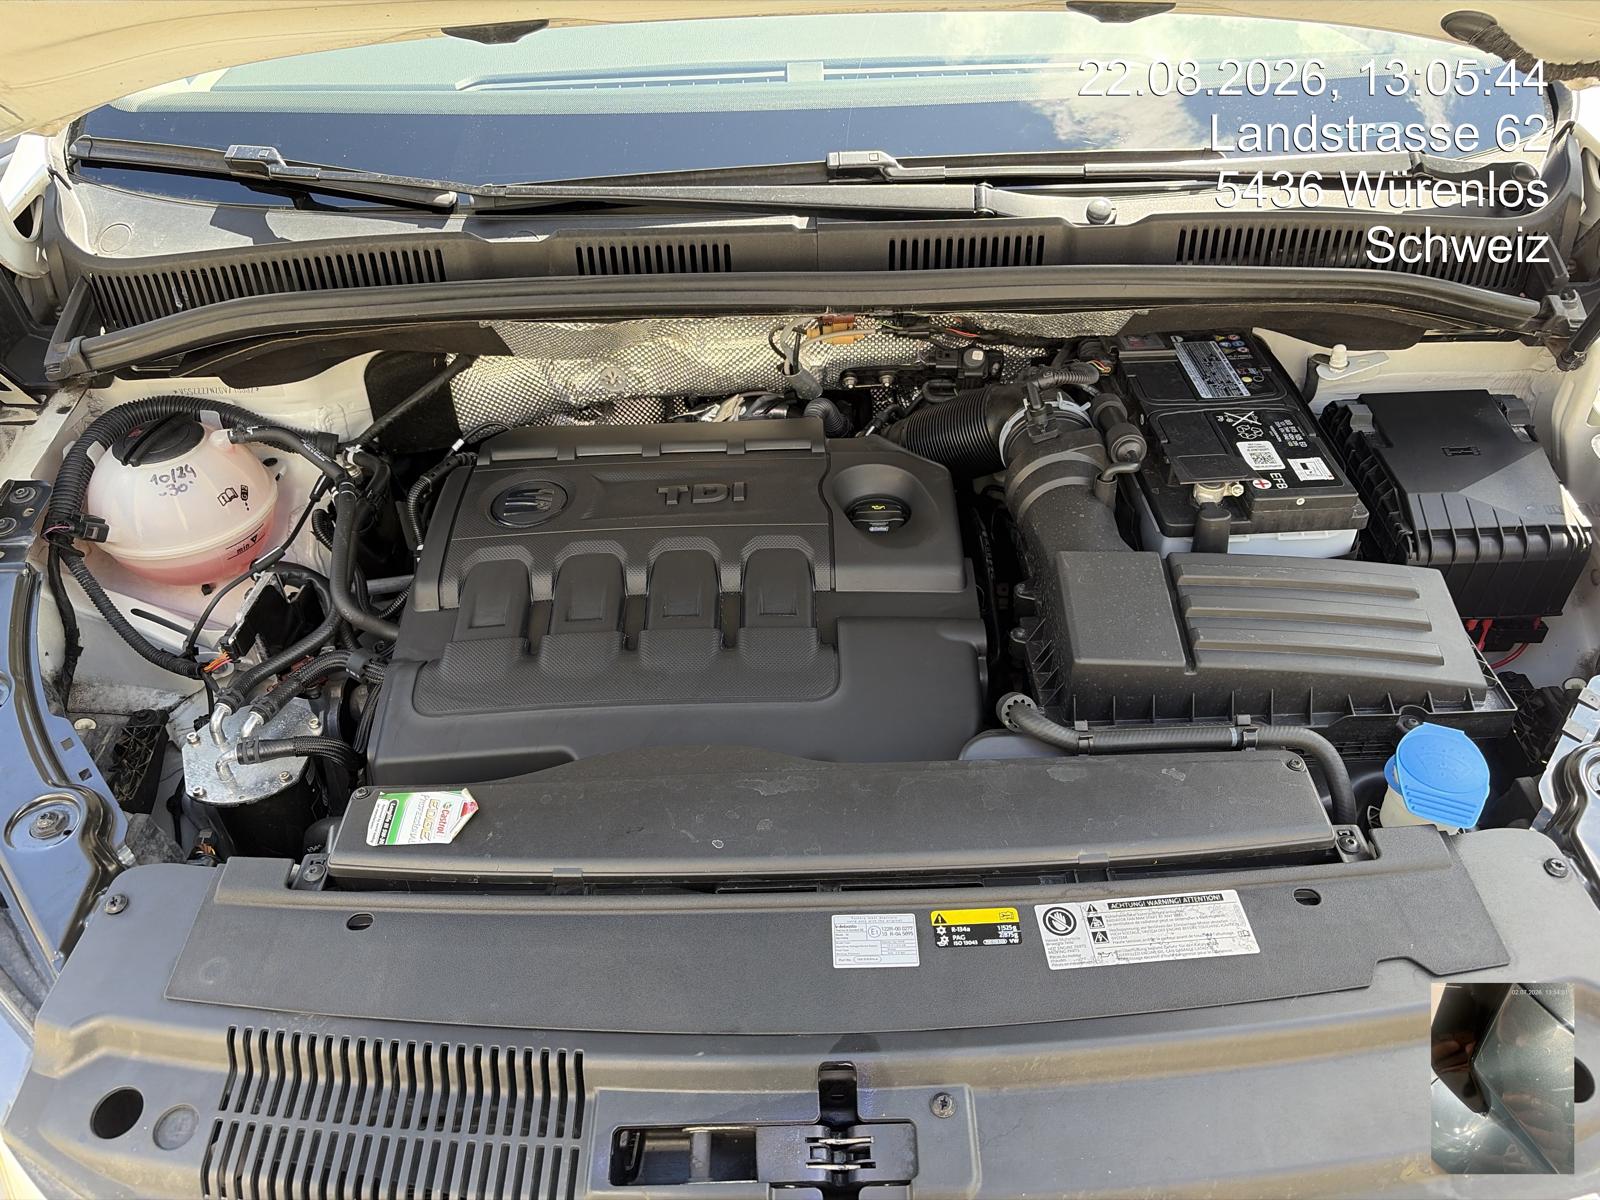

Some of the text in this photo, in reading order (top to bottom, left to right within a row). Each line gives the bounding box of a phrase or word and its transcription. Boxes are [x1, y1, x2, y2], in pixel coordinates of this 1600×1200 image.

[1270, 472, 1288, 489] EFB
[657, 482, 748, 505] TDI
[237, 543, 250, 554] min
[436, 809, 449, 834] Castrol
[1111, 894, 1220, 909] ACHTUNG! WARNING! ATTENTION!
